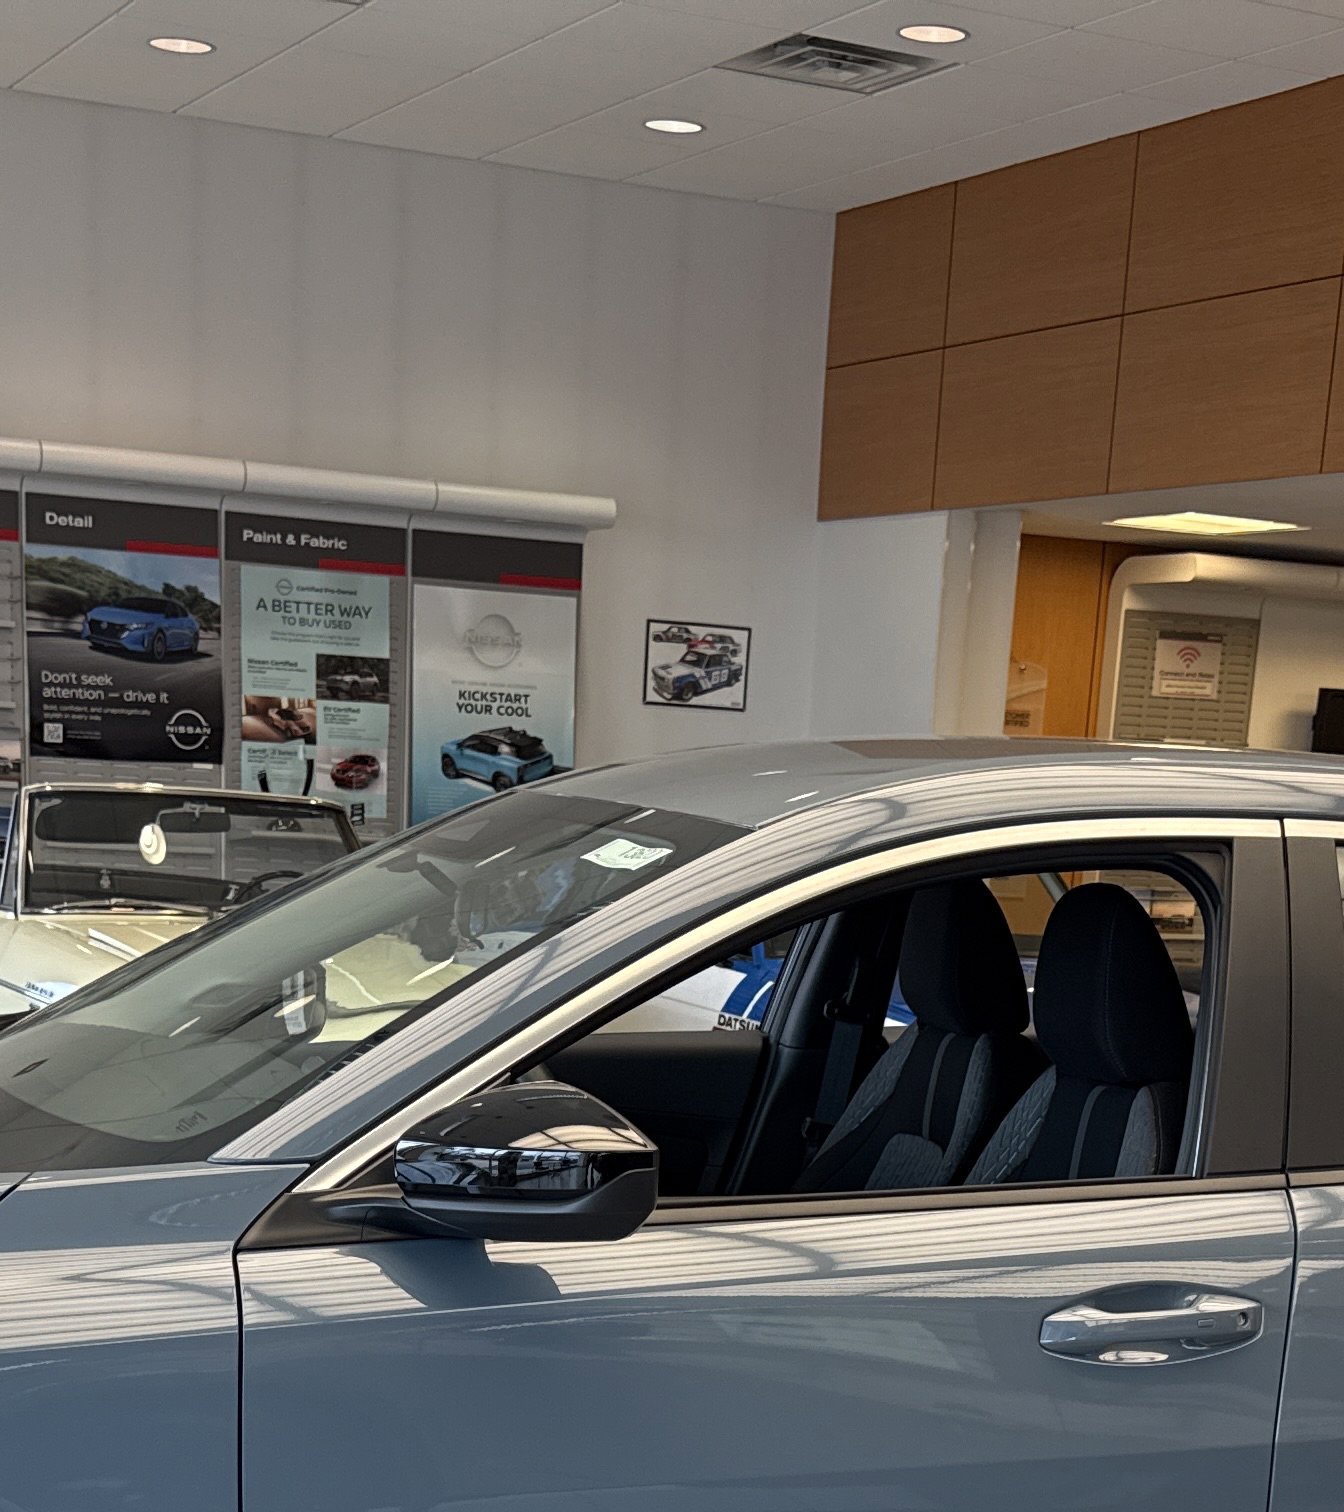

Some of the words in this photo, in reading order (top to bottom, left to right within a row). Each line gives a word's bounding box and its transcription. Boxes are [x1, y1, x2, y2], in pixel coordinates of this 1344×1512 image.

[44, 511, 93, 528] Detail
[242, 529, 282, 545] Paint
[285, 533, 297, 546] &
[300, 534, 348, 550] Fabric
[256, 597, 268, 611] A
[271, 599, 335, 617] BETTER
[338, 604, 373, 619] WAY
[281, 615, 296, 626] TO
[298, 617, 322, 628] BUY
[323, 618, 353, 630] USED
[40, 669, 77, 685] Don't
[80, 674, 114, 687] seek
[42, 686, 105, 701] attention
[123, 689, 157, 704] drive
[159, 691, 169, 704] it
[458, 689, 531, 705] KICKSTART
[456, 702, 493, 716] YOUR
[496, 704, 532, 718] COOL
[165, 725, 212, 735] NISSAN
